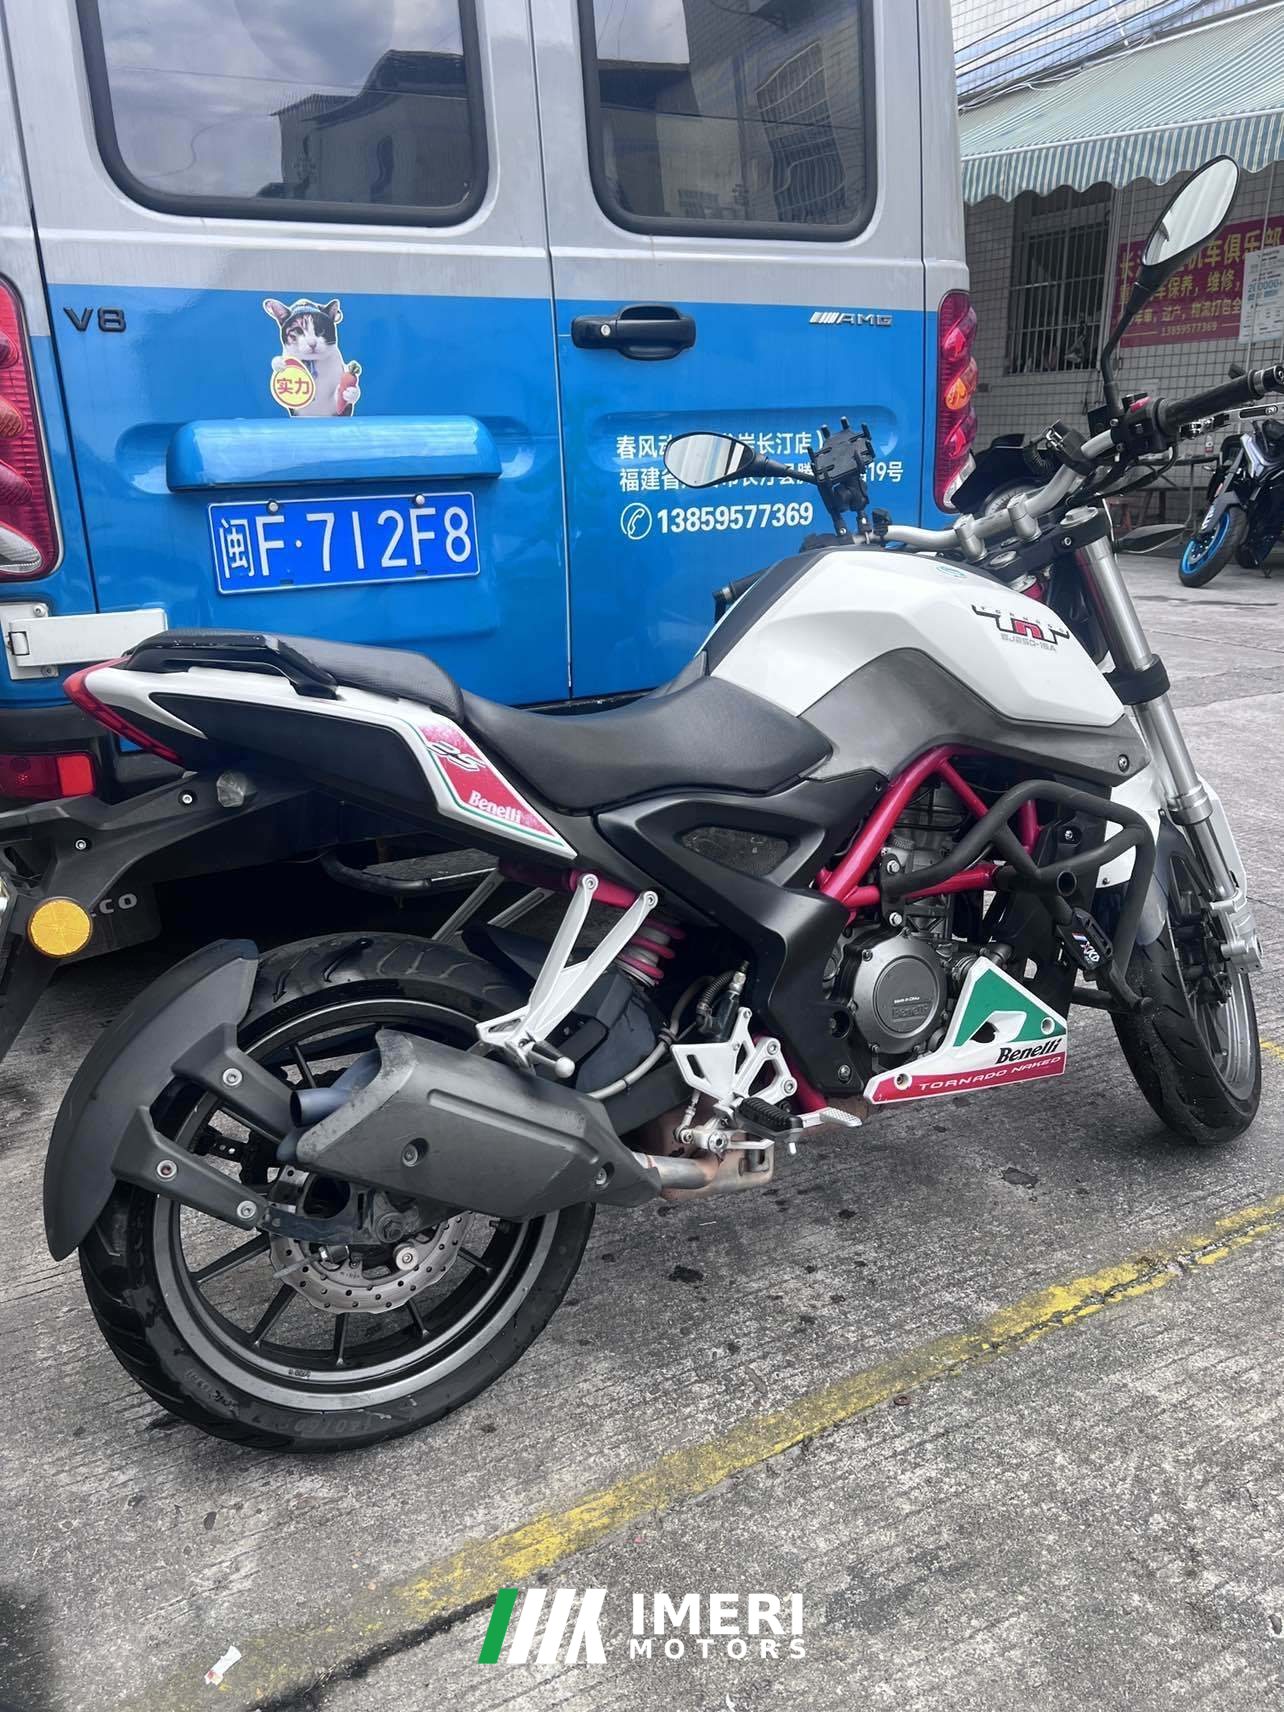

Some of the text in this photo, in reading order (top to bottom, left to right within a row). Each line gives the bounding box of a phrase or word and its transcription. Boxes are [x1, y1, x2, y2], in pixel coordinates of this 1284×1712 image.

[63, 307, 126, 332] V8
[837, 313, 893, 326] AMG
[276, 378, 311, 395] 实力
[657, 502, 813, 534] 13859577369
[468, 790, 523, 824] Benelli
[995, 1038, 1063, 1064] Benelli
[919, 1056, 1061, 1091] TORNADO NAKED
